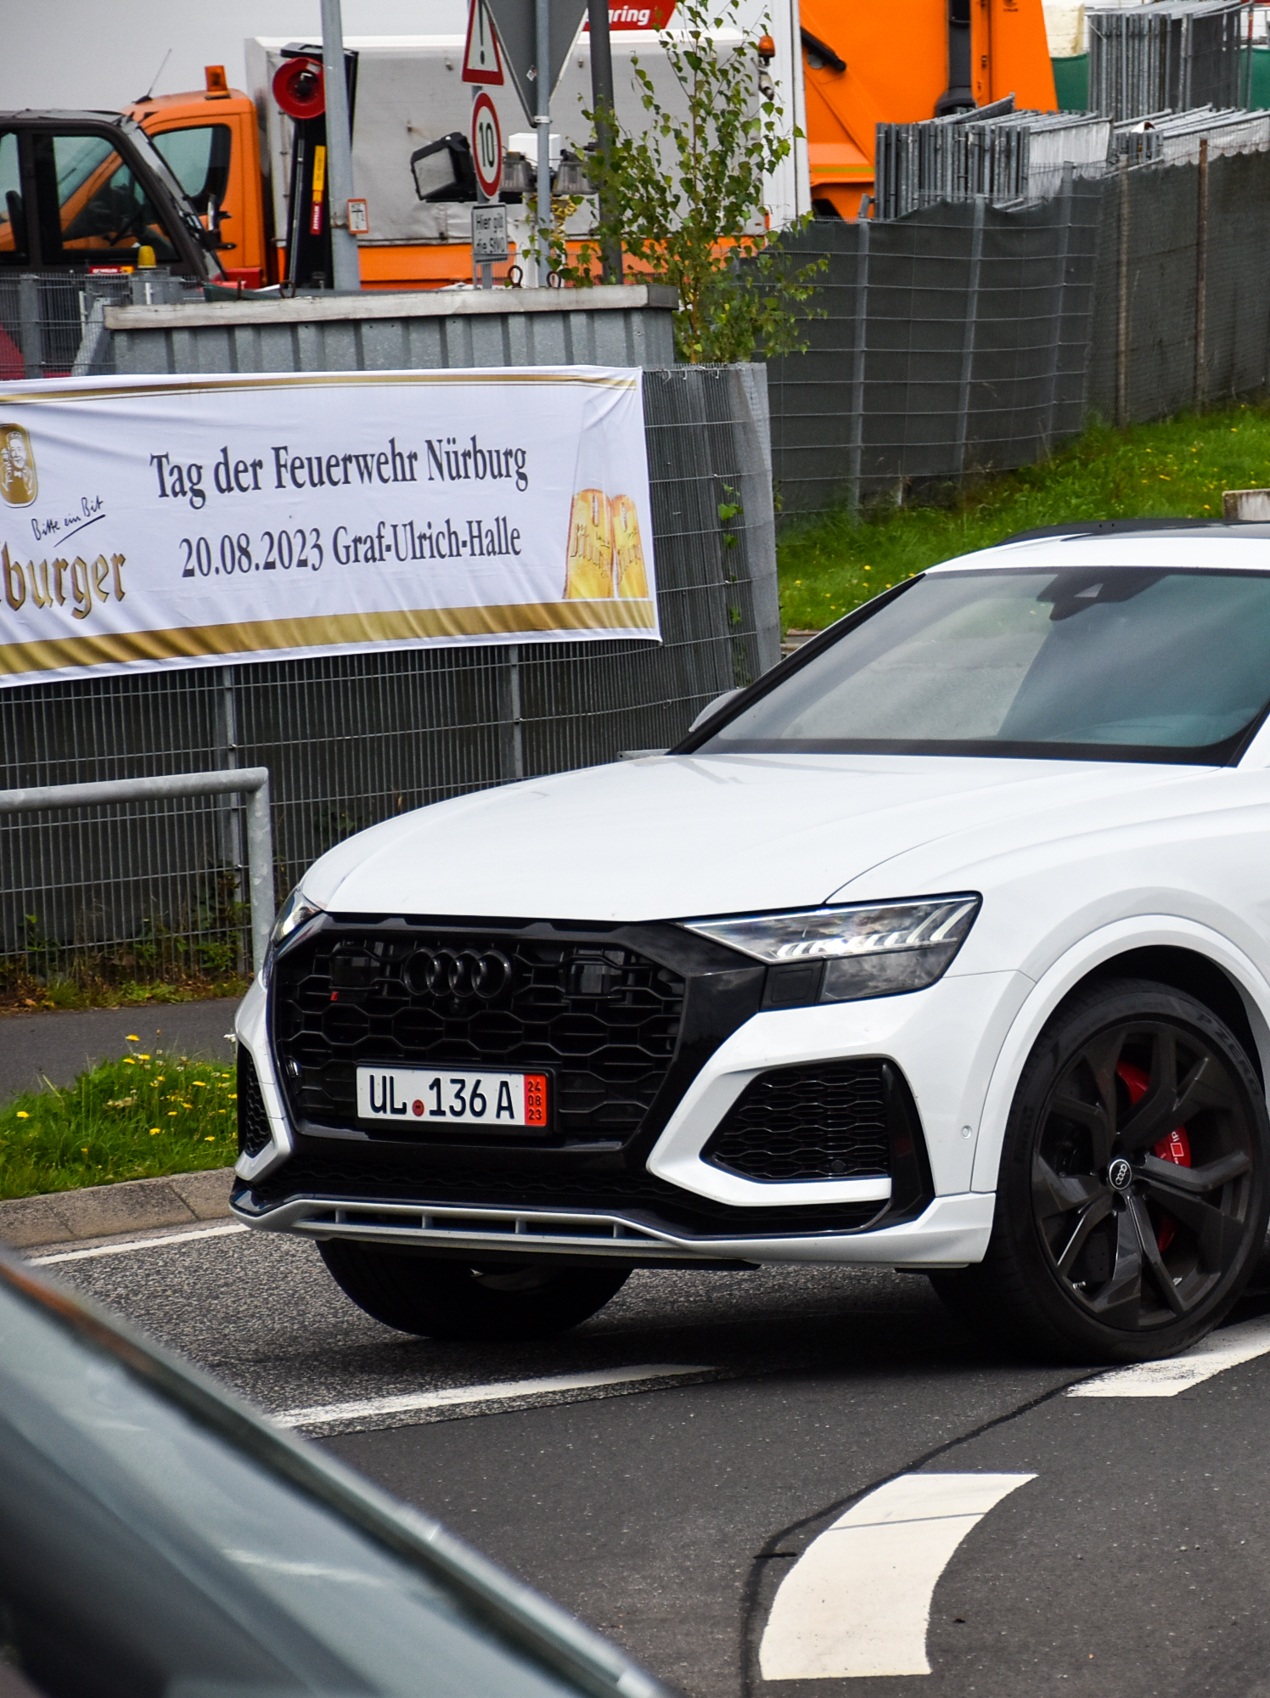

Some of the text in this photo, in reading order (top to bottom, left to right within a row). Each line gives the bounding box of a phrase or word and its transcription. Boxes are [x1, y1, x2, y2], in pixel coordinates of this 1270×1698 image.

[479, 121, 495, 168] 10
[150, 434, 529, 510] Tag der Feuerwehr Nürburg
[31, 495, 104, 541] Bitte ein Bit
[179, 528, 324, 578] 20.08.2023
[332, 515, 522, 566] Graf-Ulrich-Halle
[369, 1074, 515, 1120] UL 136 A
[527, 1081, 542, 1093] 24
[527, 1095, 542, 1107] 08
[528, 1109, 542, 1121] 23
